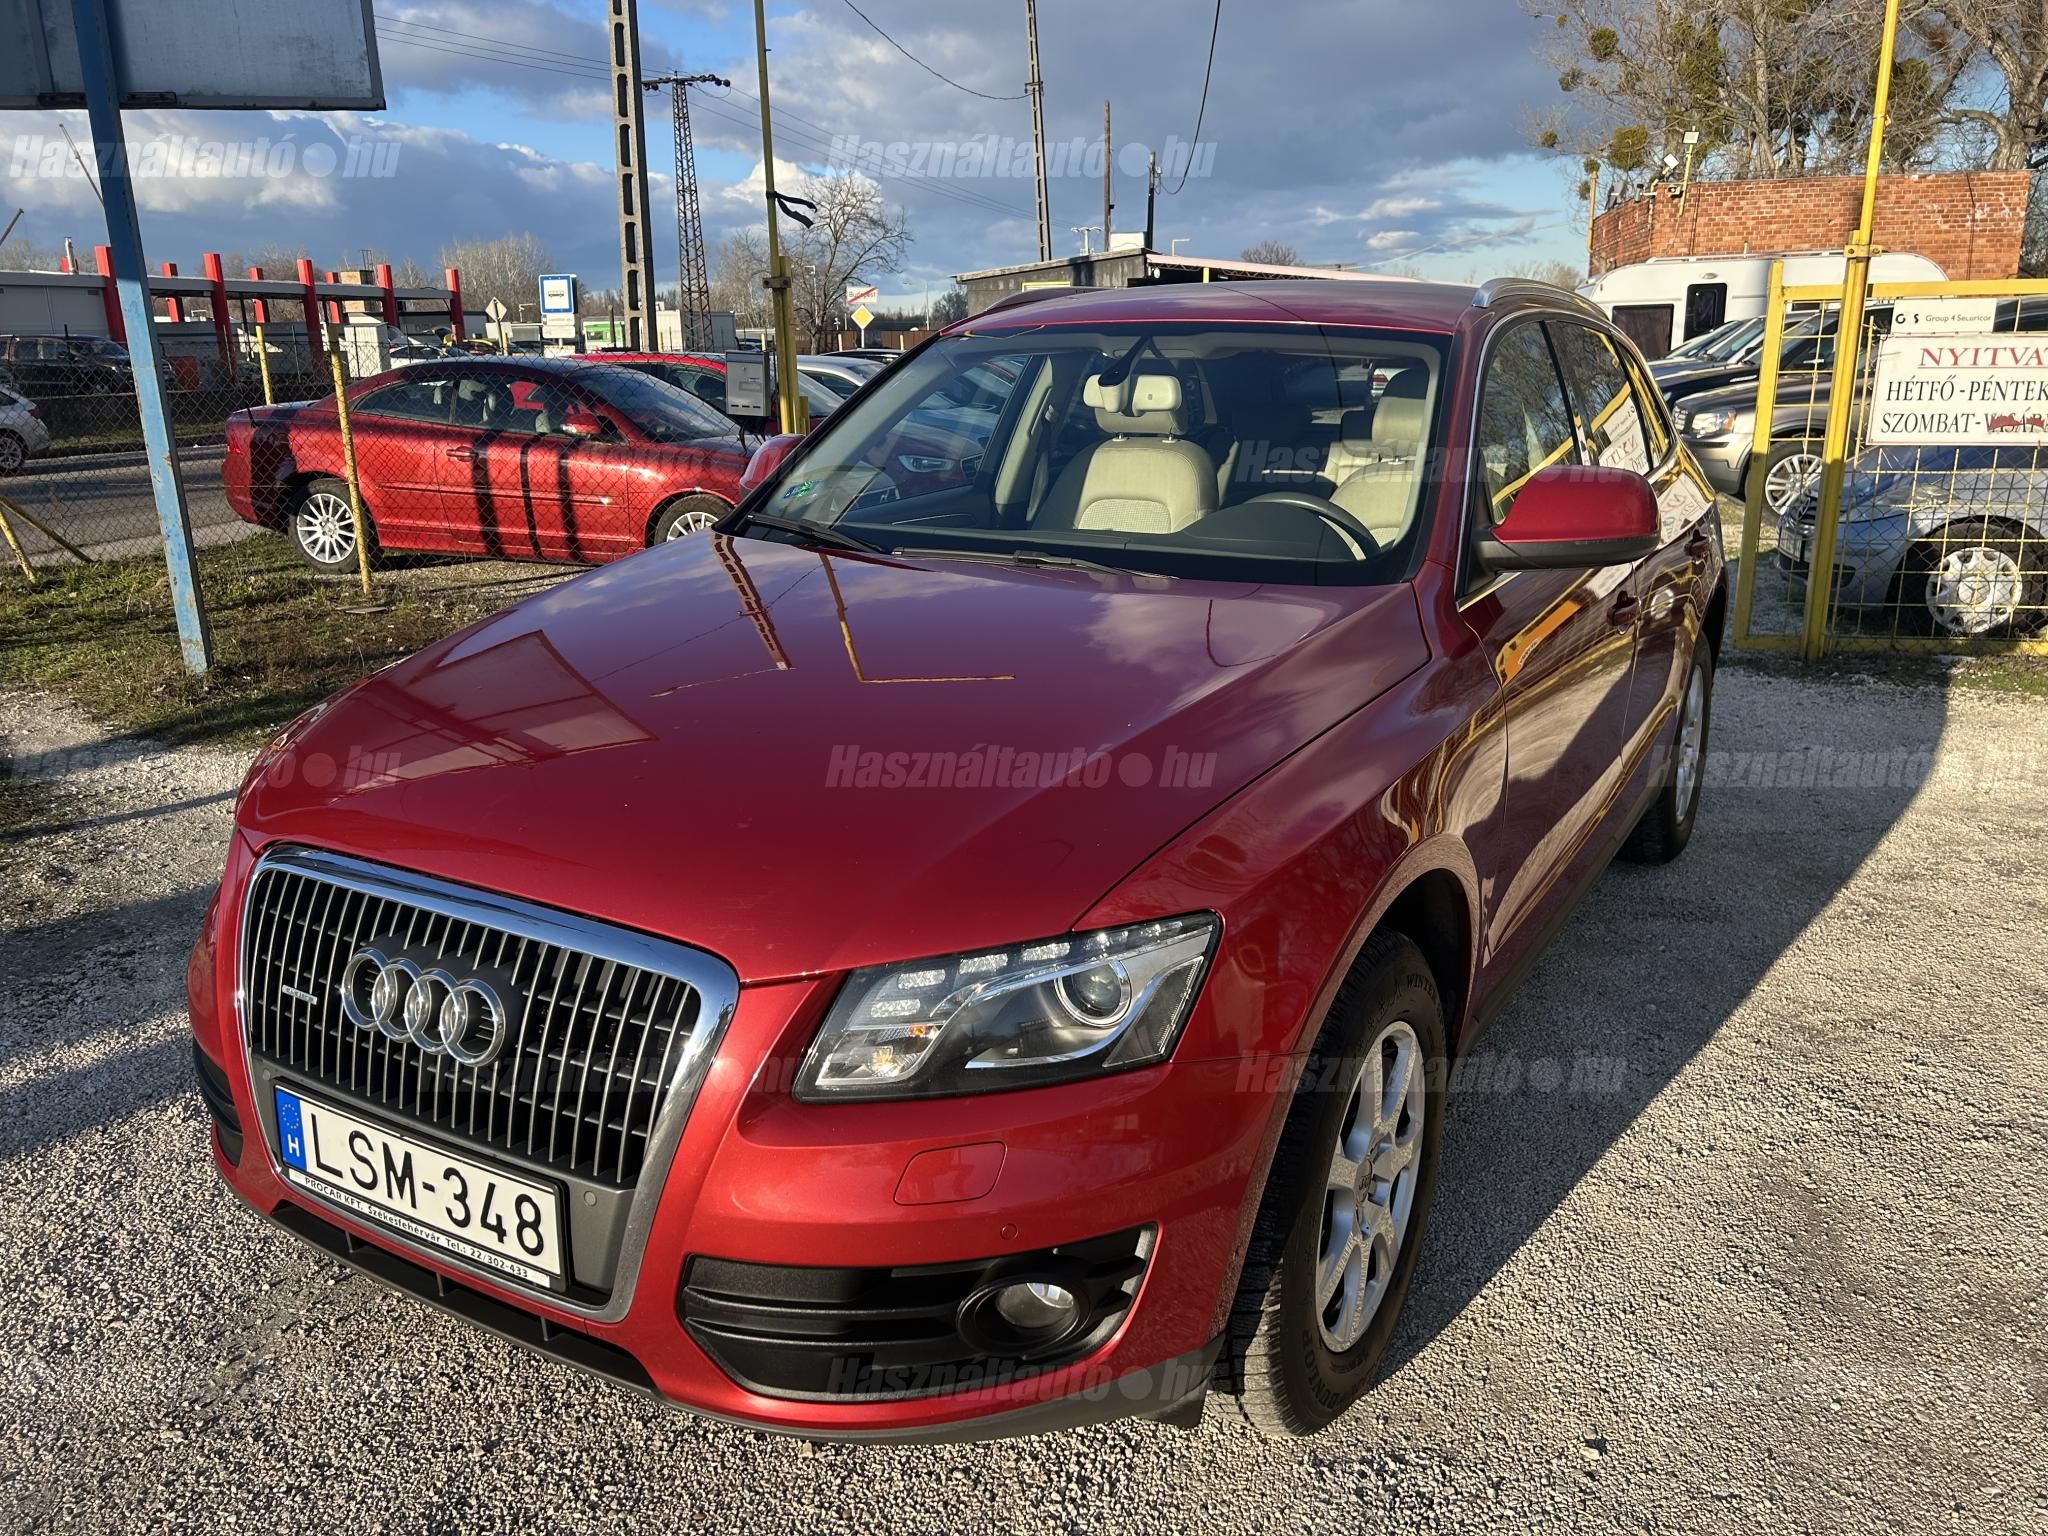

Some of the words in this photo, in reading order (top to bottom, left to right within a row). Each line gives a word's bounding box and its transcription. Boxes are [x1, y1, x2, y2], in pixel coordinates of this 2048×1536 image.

[1919, 347, 2048, 366] NYITVA
[287, 1134, 300, 1158] H
[310, 1112, 544, 1257] LSM-348
[305, 1177, 342, 1200] PROCAR
[344, 1195, 364, 1210] KFT.
[368, 1205, 440, 1243] Székesfehérvár
[445, 1238, 466, 1253] Tel.:
[470, 1247, 528, 1278] 22/302-433
